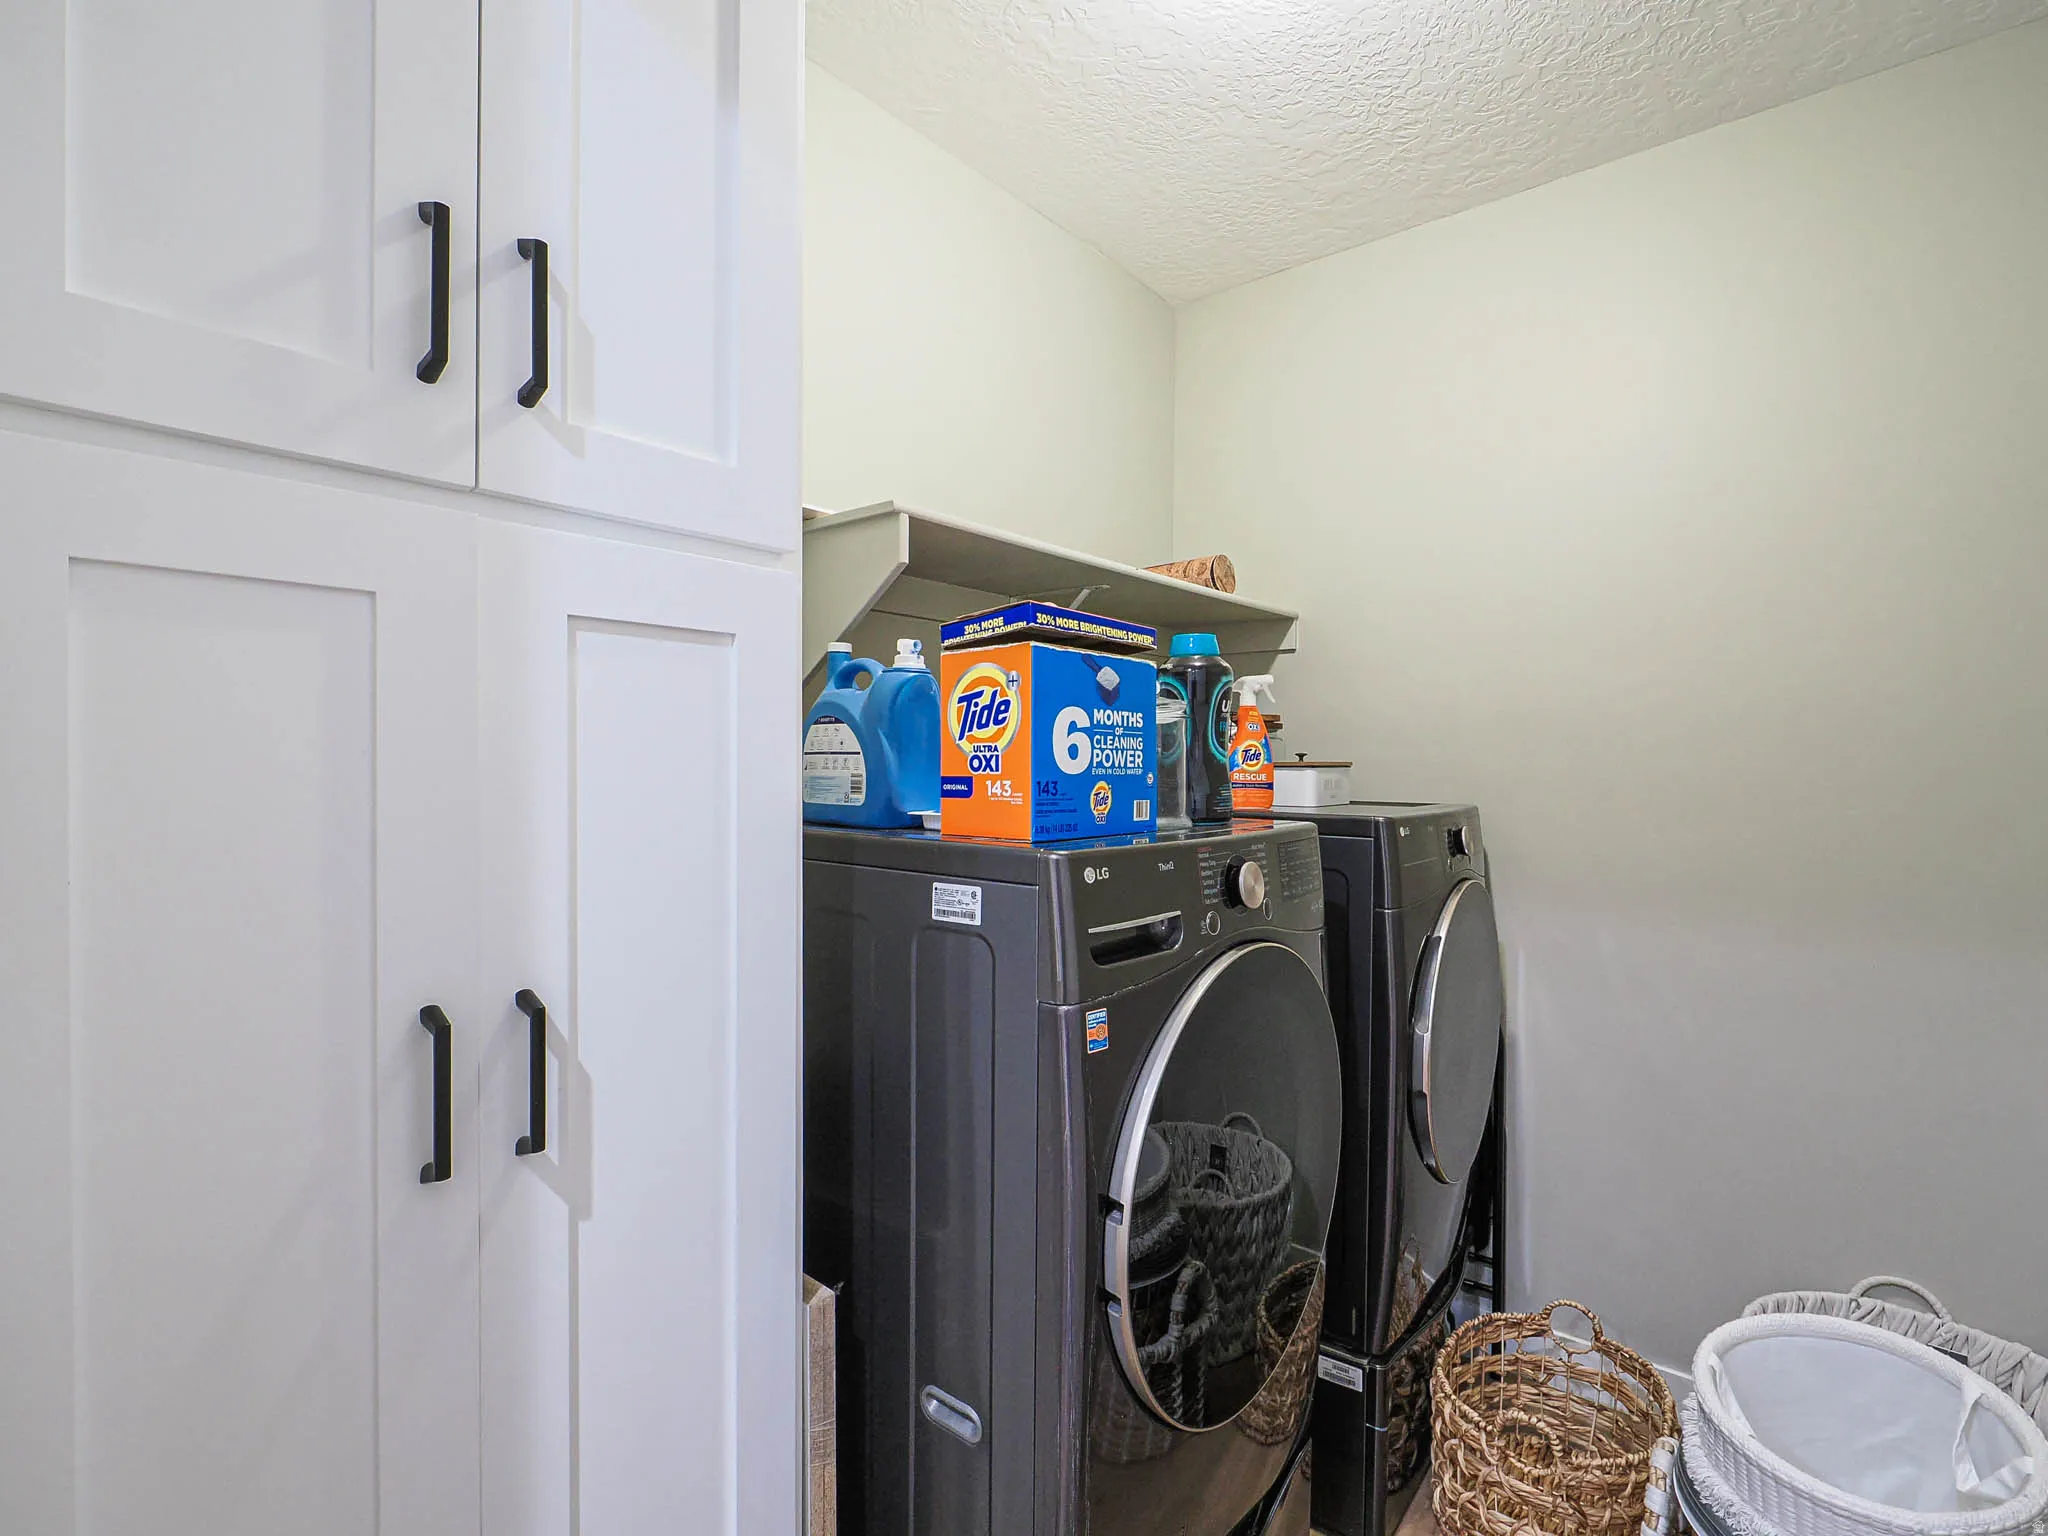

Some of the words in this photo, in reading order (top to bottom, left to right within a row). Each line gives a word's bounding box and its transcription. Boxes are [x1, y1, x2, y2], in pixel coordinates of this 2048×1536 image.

[964, 622, 981, 635] 30%
[981, 616, 1005, 632] MORE
[1036, 612, 1055, 626] 30%
[1055, 616, 1080, 630] MORE
[1080, 622, 1128, 640] BRIGHTENING
[957, 688, 1012, 743] Tide
[1093, 708, 1144, 728] MONTHS
[1114, 727, 1124, 736] OF
[973, 744, 999, 753] ULTRA
[1052, 706, 1092, 775] 6
[1093, 734, 1144, 750] CLEANING
[968, 754, 1000, 773] OXI
[1092, 749, 1143, 768] POWER
[1241, 749, 1262, 765] Tide
[1091, 767, 1106, 775] EVEN
[1106, 767, 1112, 775] IN
[1112, 767, 1126, 775] COLD
[1232, 772, 1268, 781] RESCUE
[942, 783, 968, 791] ORIGINAL
[985, 779, 1012, 797] 143
[1036, 781, 1058, 797] 143
[1093, 791, 1110, 810] Tide
[1096, 867, 1110, 880] LG
